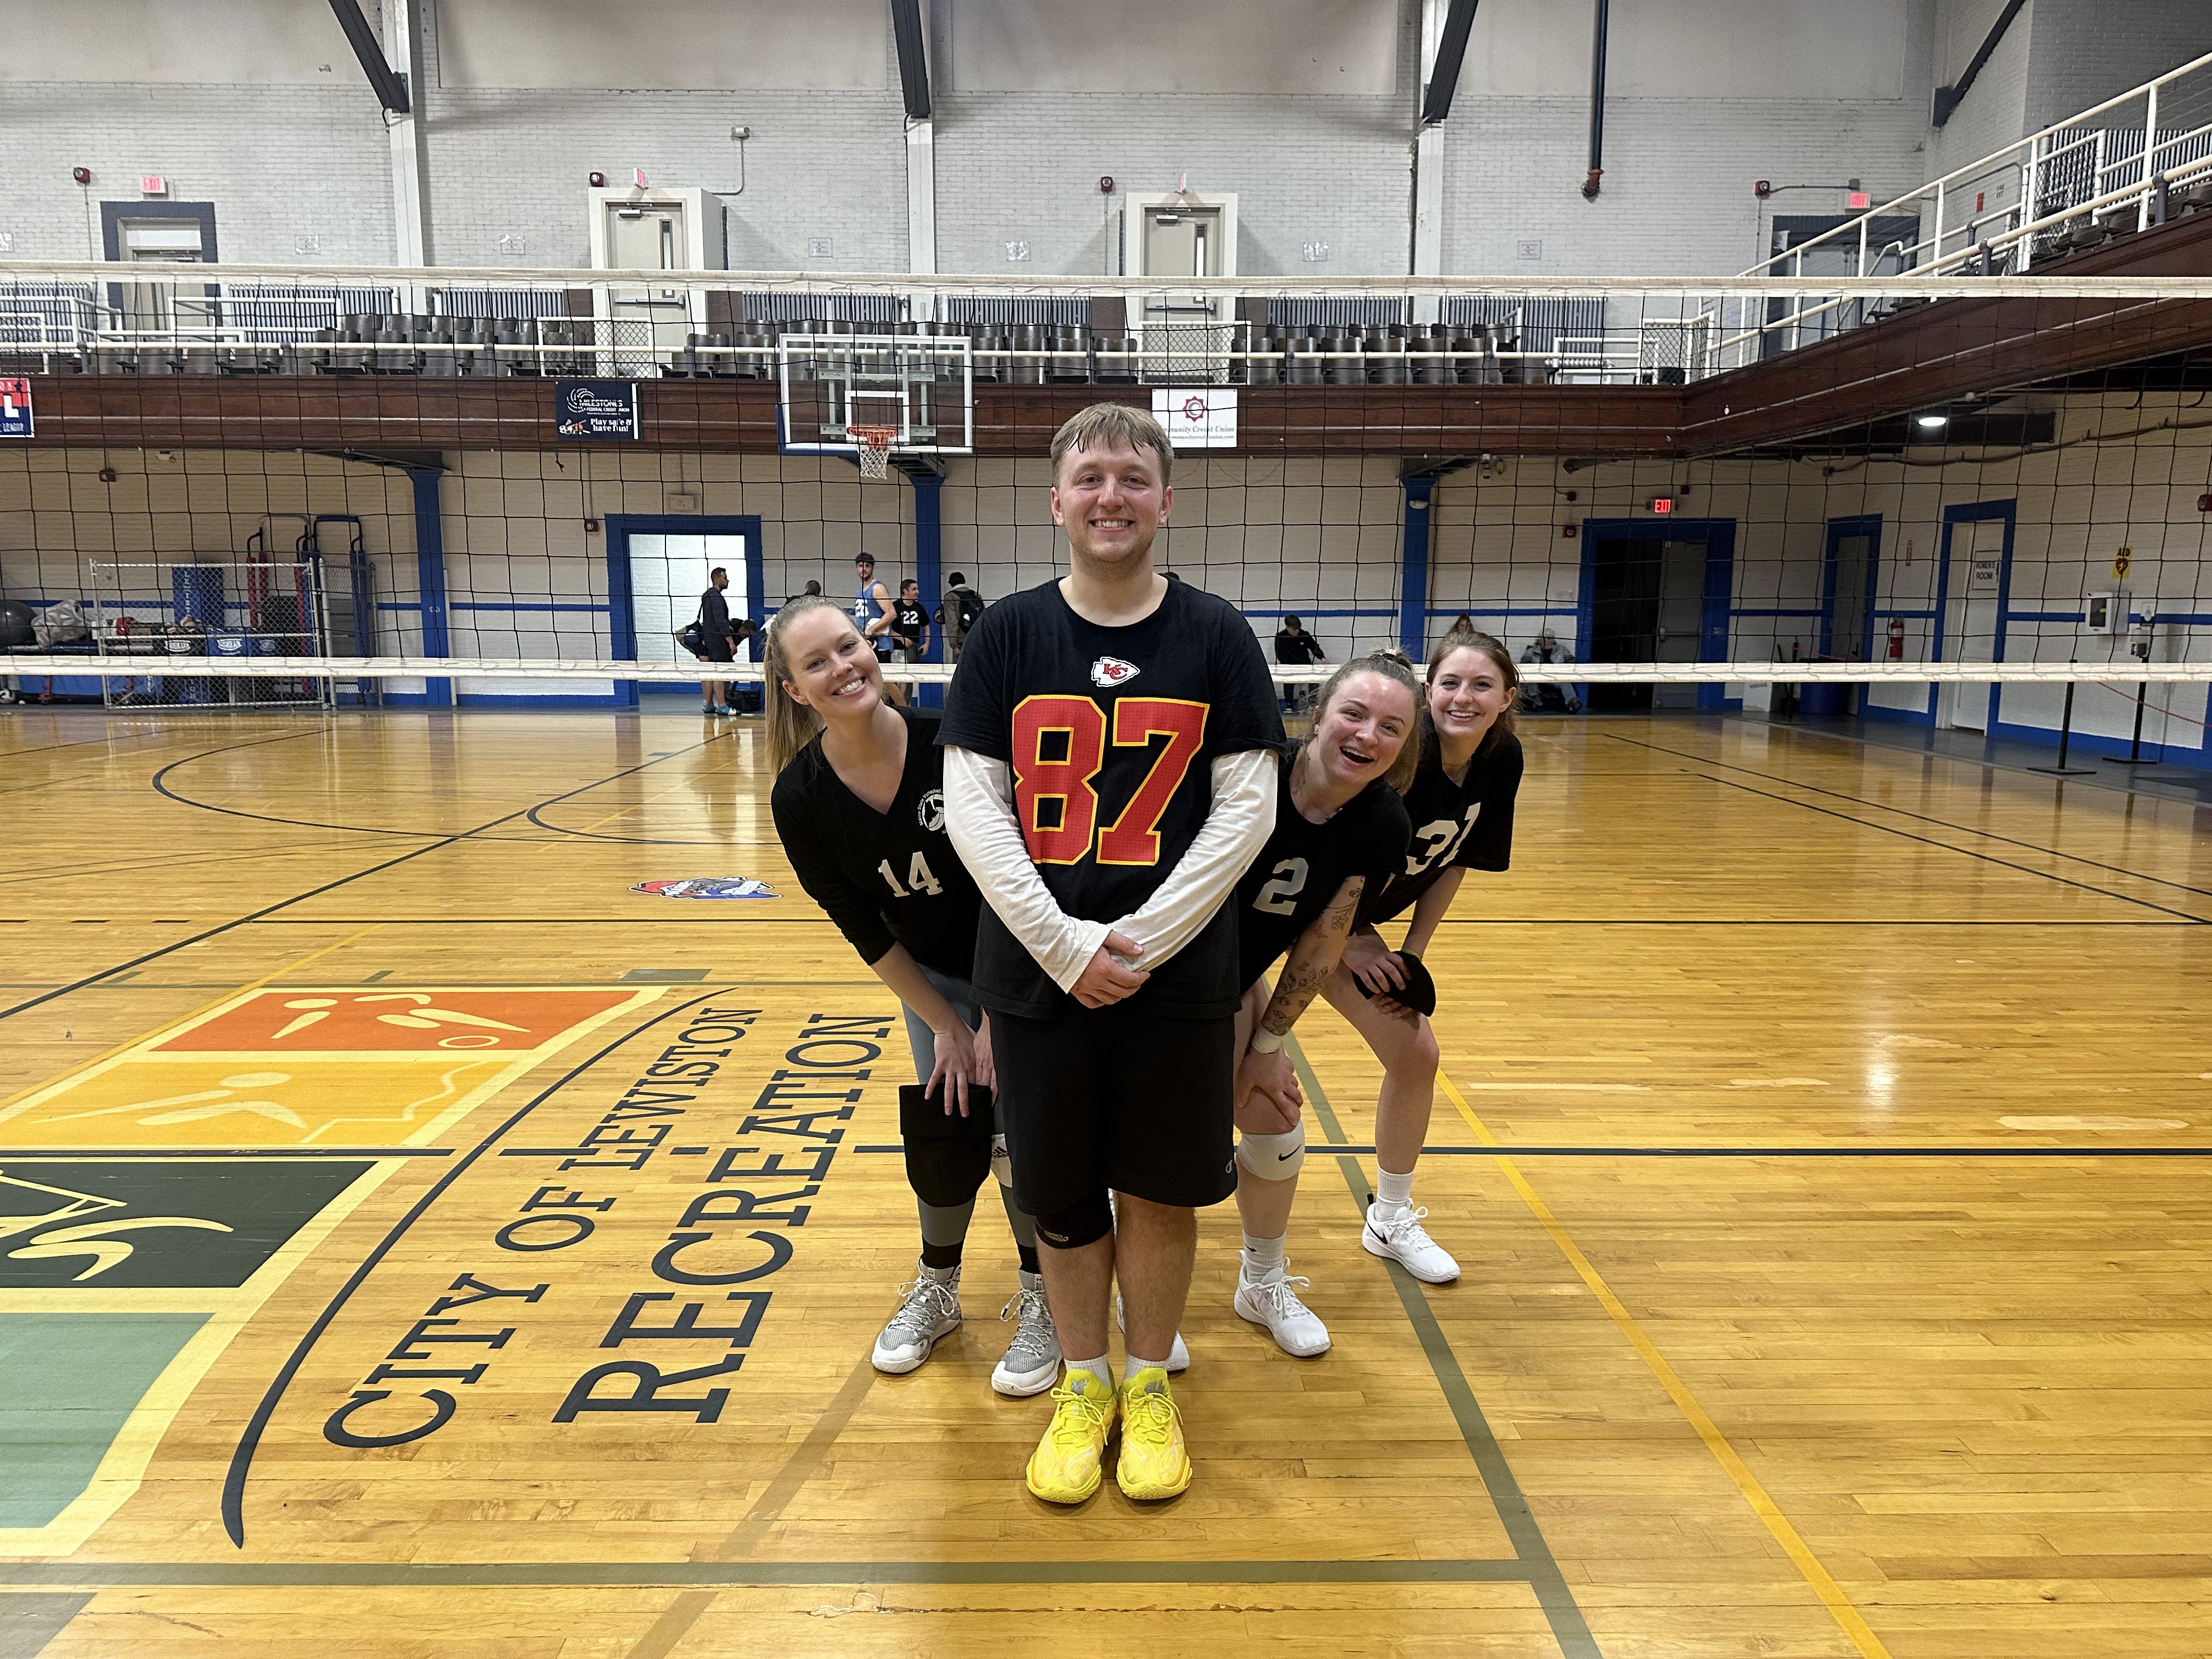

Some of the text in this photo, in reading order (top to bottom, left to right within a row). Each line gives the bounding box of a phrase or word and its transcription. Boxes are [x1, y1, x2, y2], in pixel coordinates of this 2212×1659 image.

[579, 399, 623, 407] MILESTONES
[590, 418, 607, 427] Play
[1163, 426, 1190, 434] mmunity
[1655, 499, 1671, 513] EXIT
[1976, 572, 1993, 580] ROOM
[900, 610, 919, 625] 22
[1103, 663, 1128, 680] KC
[1012, 695, 1210, 866] 87
[1406, 802, 1481, 875] 31
[878, 851, 944, 898] 14
[1252, 857, 1309, 916] 2
[551, 1013, 896, 1424] RECREATION
[323, 1008, 763, 1448] CITY OF LEWISTON
